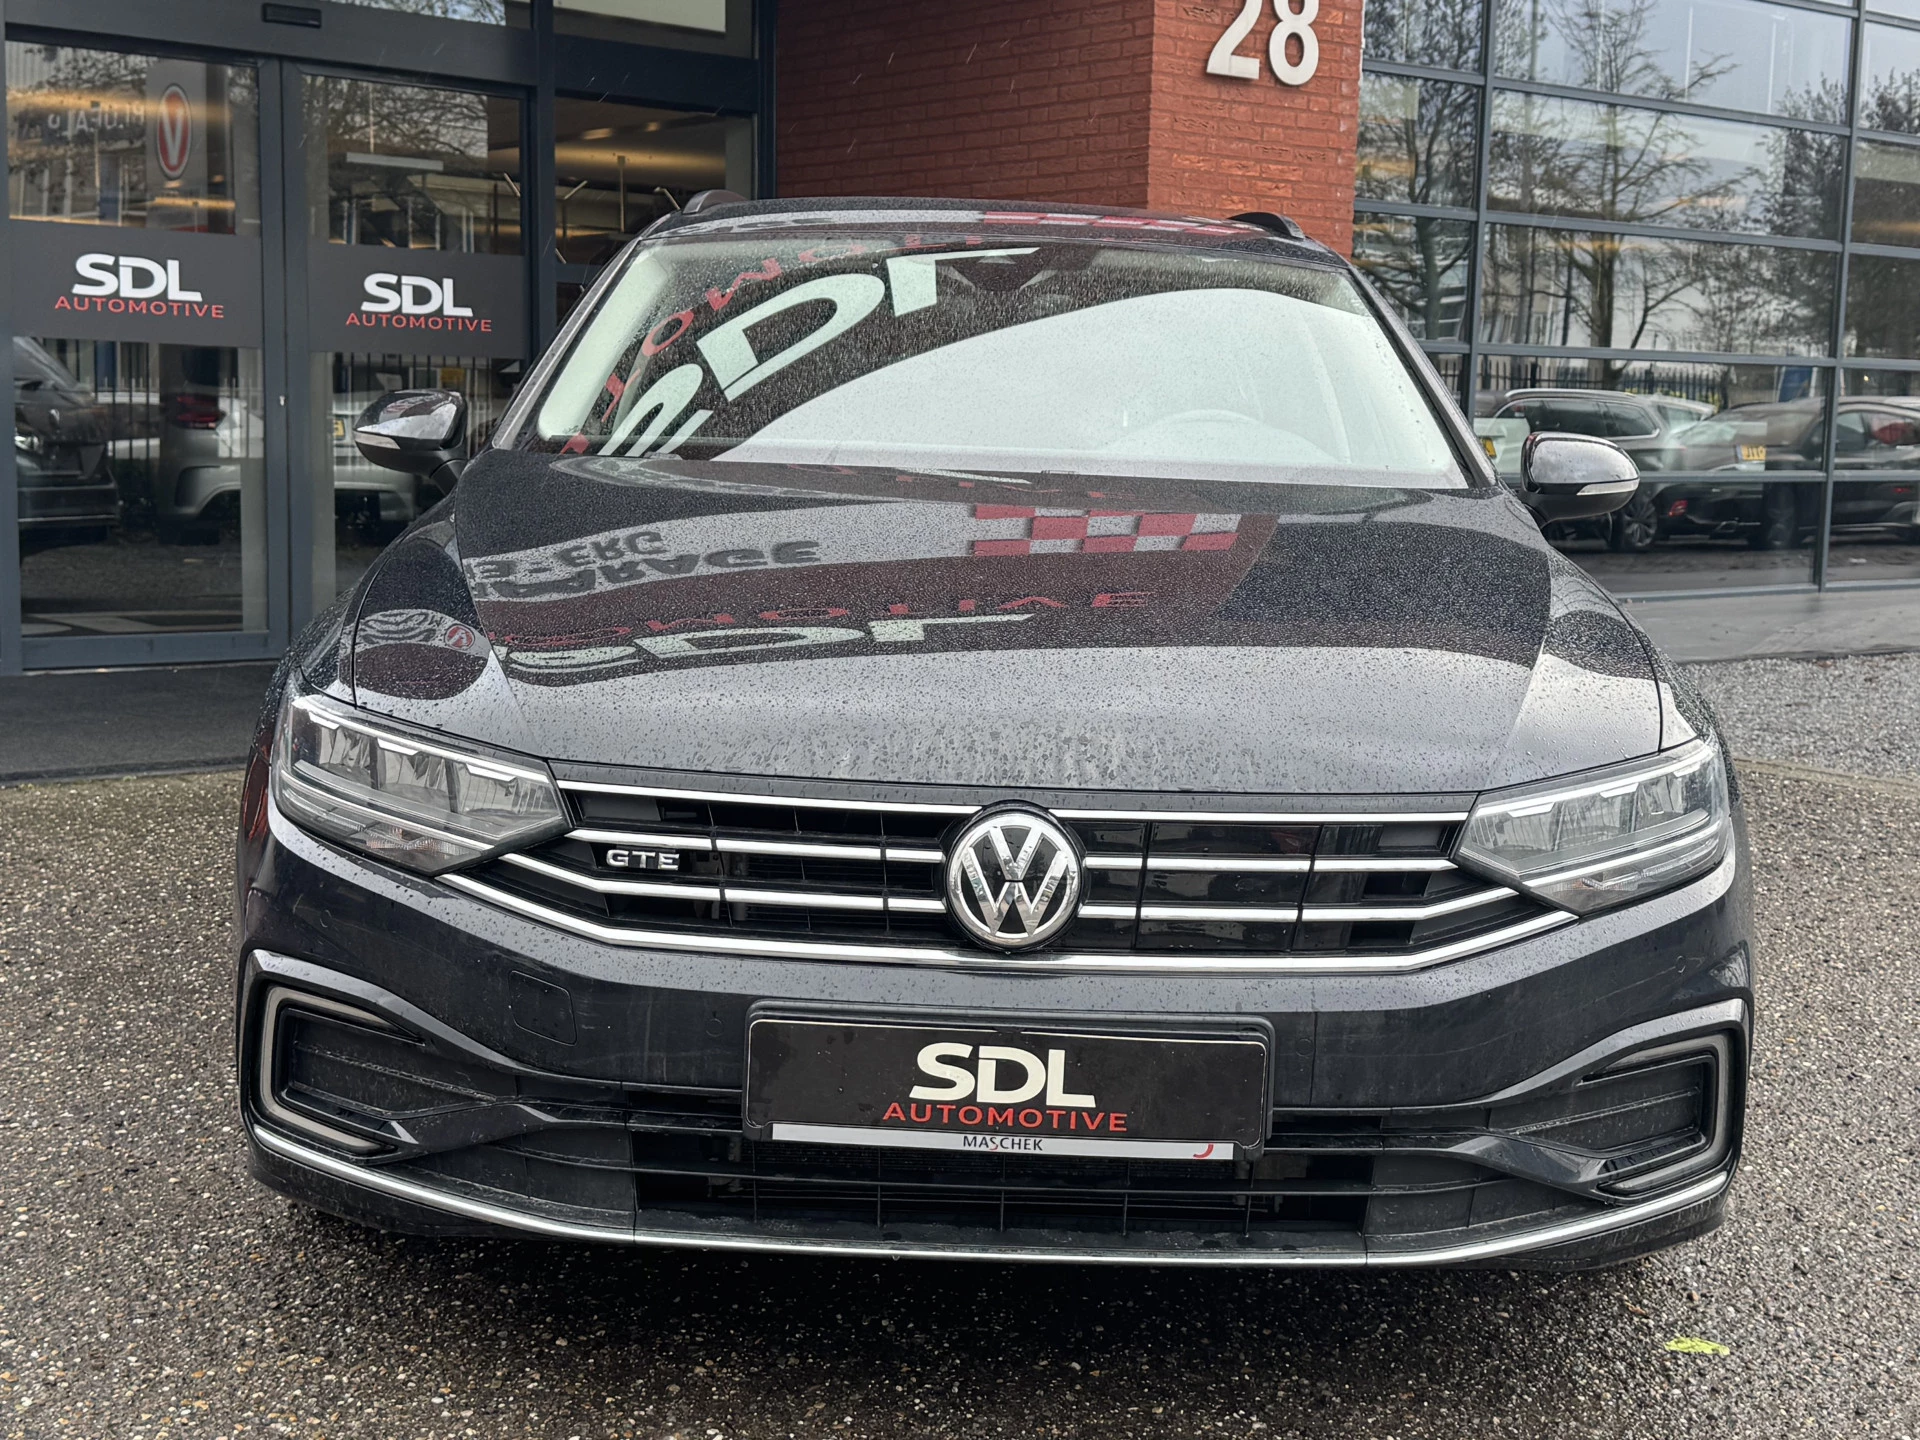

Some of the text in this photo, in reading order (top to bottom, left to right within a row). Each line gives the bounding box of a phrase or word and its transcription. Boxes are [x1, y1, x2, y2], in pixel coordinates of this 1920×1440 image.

[1206, 0, 1320, 86] 28
[71, 253, 203, 302] SDL
[360, 272, 474, 317] SDL
[54, 295, 224, 319] AUTOMOTIVE
[345, 312, 492, 332] AUTOMOTIVE
[606, 848, 680, 872] GTE
[952, 812, 1078, 944] VW
[908, 1042, 1097, 1109] SDL
[882, 1102, 1128, 1133] AUTOMOTIVE
[962, 1134, 1044, 1153] MASCHEK
